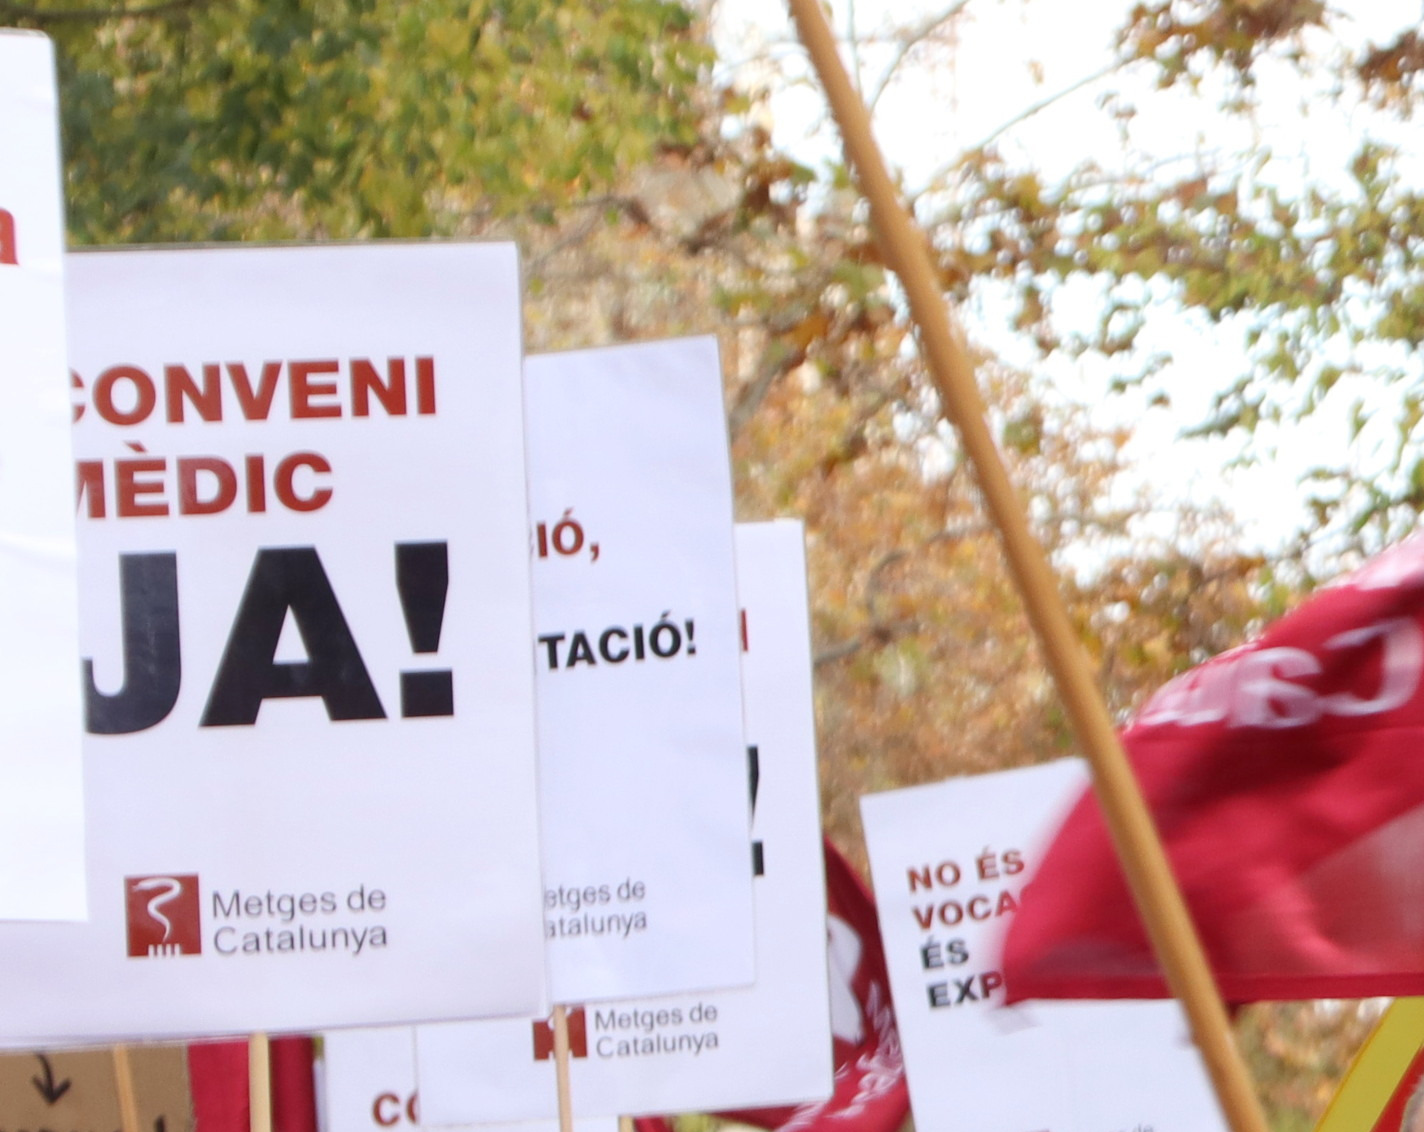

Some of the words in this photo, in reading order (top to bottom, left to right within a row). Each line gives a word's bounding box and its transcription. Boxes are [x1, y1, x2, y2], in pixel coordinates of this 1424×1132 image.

[537, 506, 600, 564] IÓ,
[83, 541, 454, 734] JA!
[538, 609, 697, 671] TACIÓ!
[907, 861, 961, 893] NO
[975, 845, 1025, 881] ÉS
[212, 889, 337, 924] Metges
[346, 884, 387, 913] de
[616, 877, 646, 902] de
[213, 925, 387, 957] Catalunya
[920, 935, 969, 971] ÉS
[595, 1007, 683, 1034] Metges
[689, 1001, 718, 1024] de
[595, 1030, 719, 1058] Catalunya
